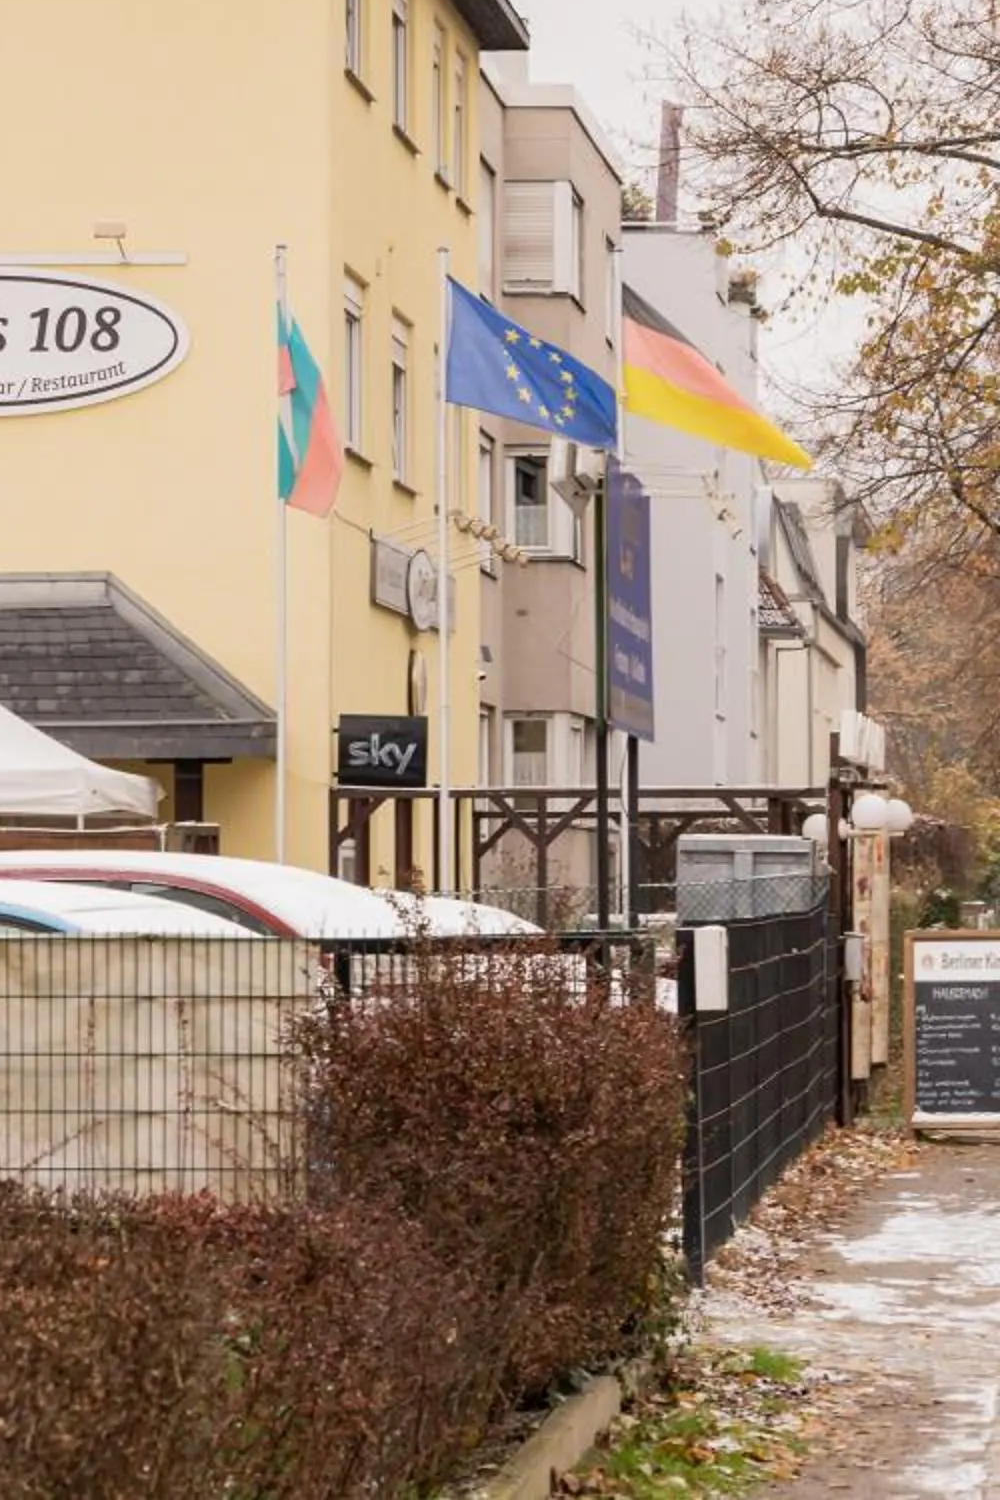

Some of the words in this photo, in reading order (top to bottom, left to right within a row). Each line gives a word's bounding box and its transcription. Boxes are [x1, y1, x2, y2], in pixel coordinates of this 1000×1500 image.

[29, 306, 122, 353] 108
[31, 360, 127, 393] Restaurant
[349, 732, 417, 775] sky
